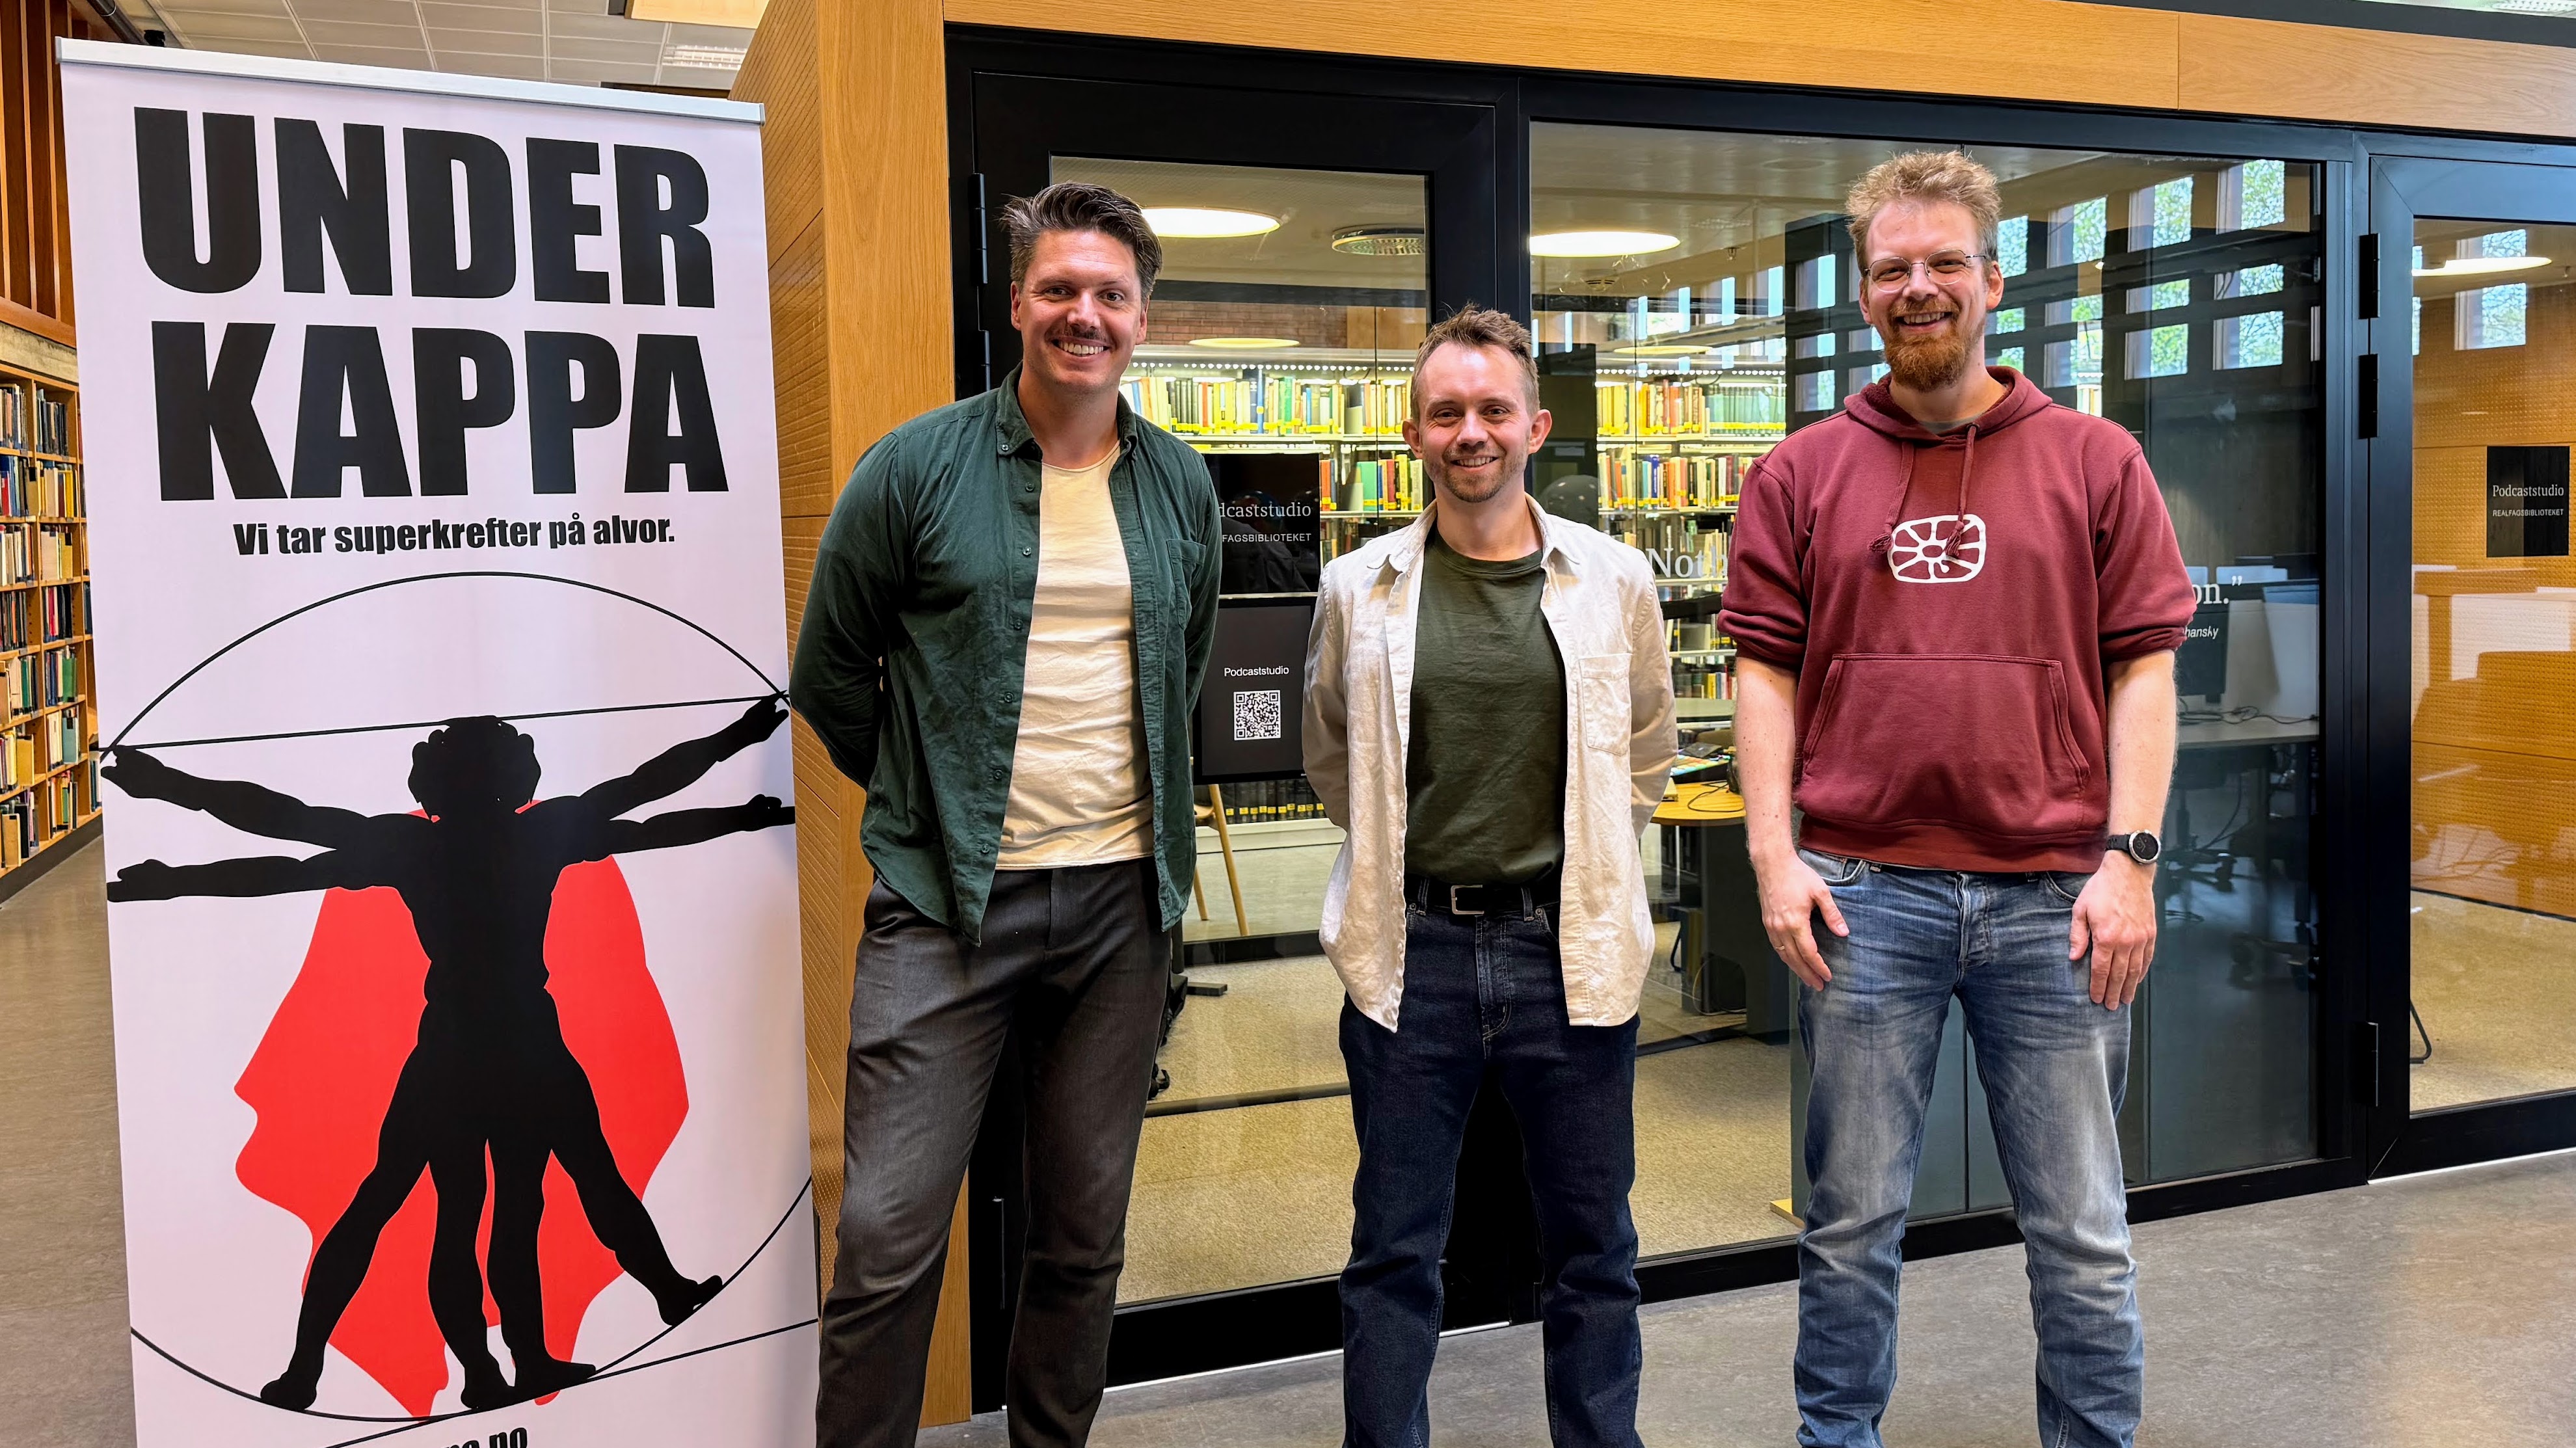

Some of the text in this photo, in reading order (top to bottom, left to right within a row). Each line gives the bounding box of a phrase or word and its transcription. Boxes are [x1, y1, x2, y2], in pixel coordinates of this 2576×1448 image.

[134, 107, 715, 308] UNDER
[152, 321, 729, 501] KAPPA
[2492, 484, 2564, 497] Podcaststudio
[1218, 502, 1311, 517] dcaststudio
[2492, 508, 2564, 517] REALFAGSBIBLIOTEKET
[233, 512, 675, 556] Vi tar superkrefter på alvor.
[1222, 533, 1311, 543] FAGSBIBLIOTEKET
[1645, 546, 1728, 578] Noth
[2184, 625, 2219, 639] hansky
[1224, 665, 1290, 677] Podcaststudio
